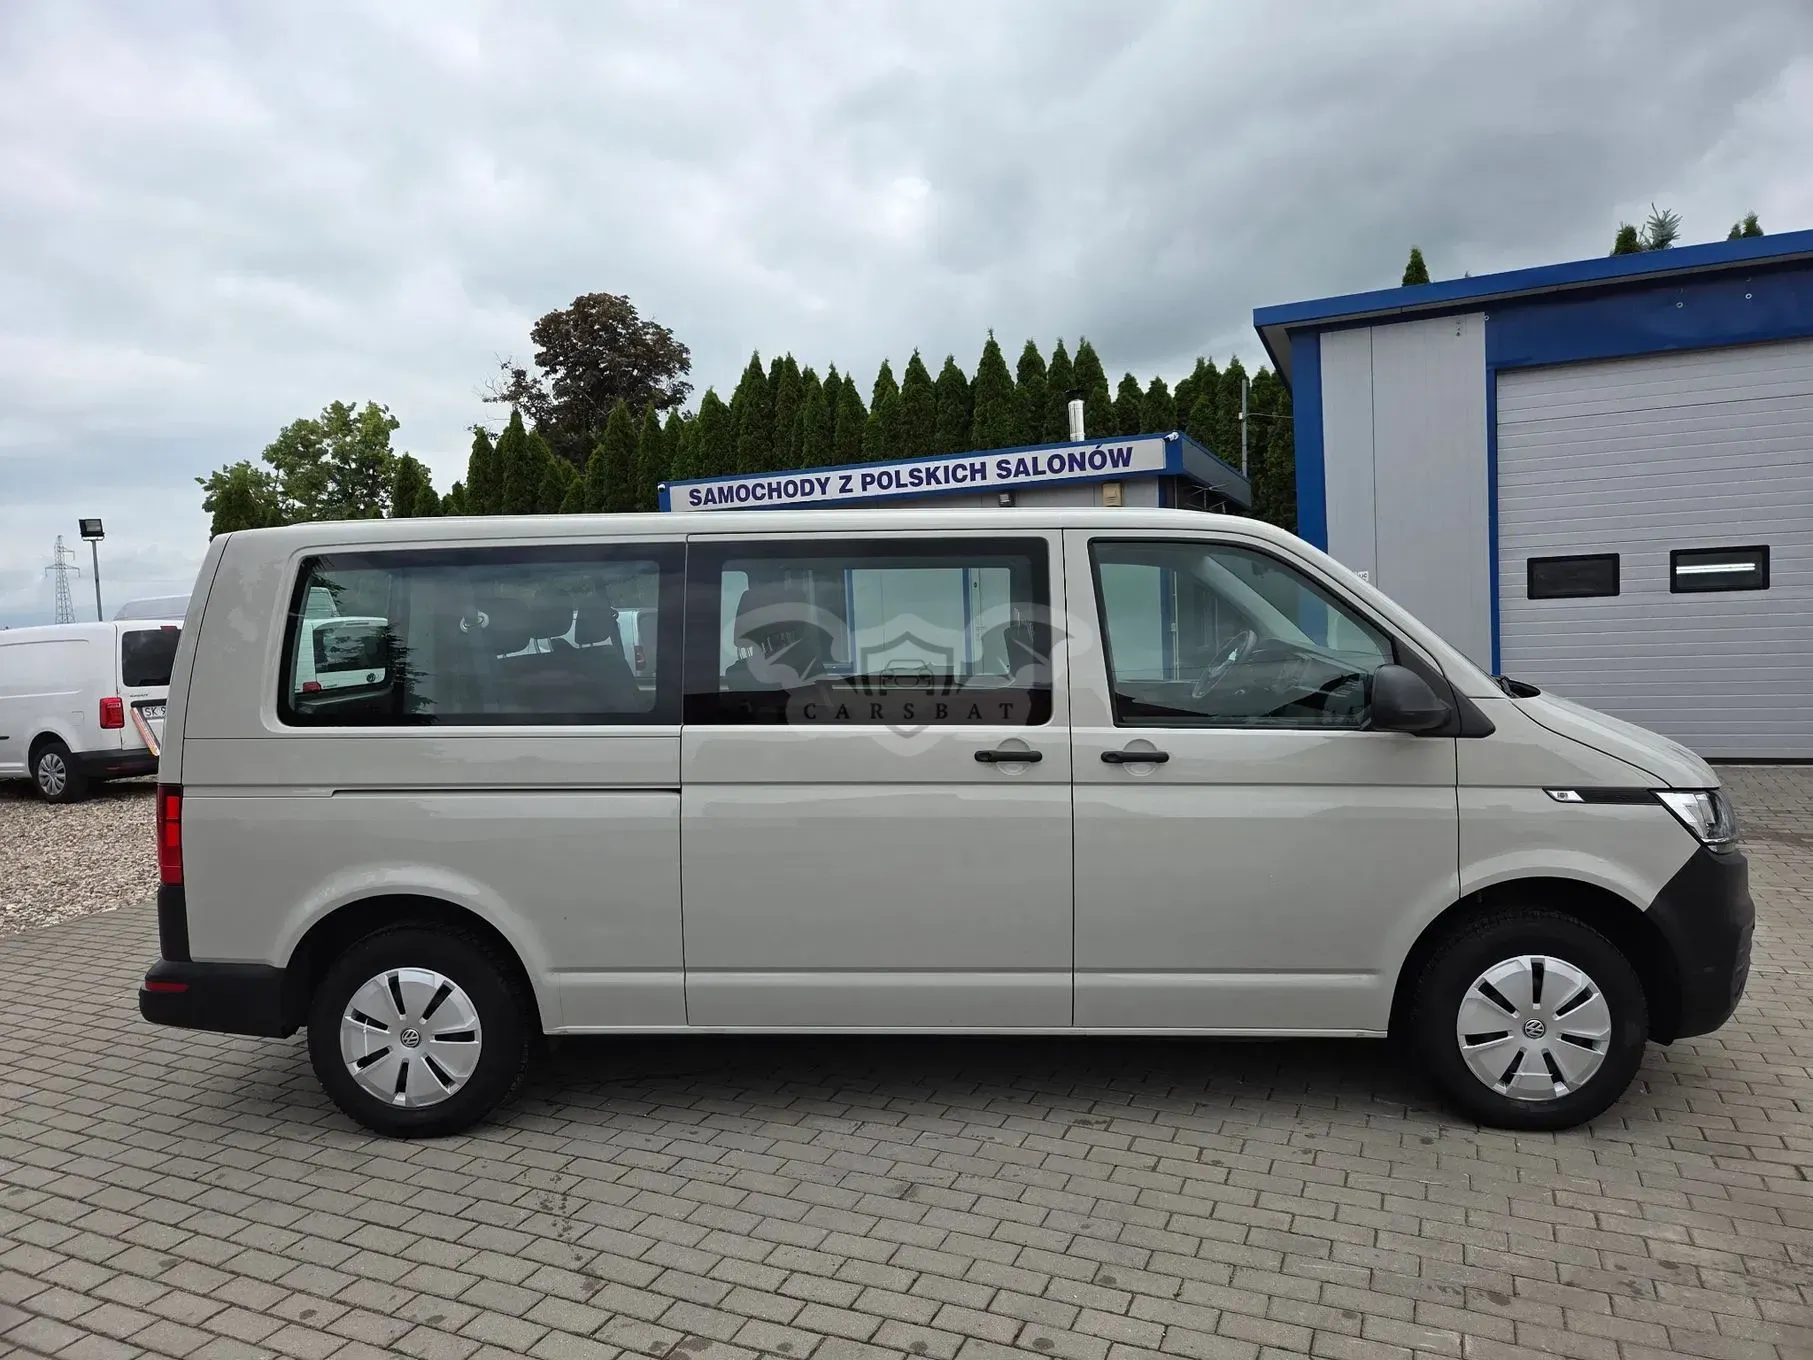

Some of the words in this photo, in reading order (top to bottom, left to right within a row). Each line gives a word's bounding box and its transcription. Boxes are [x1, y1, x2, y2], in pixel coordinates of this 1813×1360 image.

[689, 476, 831, 507] SAMOCHODY
[838, 474, 854, 494] Z
[861, 461, 987, 492] POLSKICH
[996, 443, 1133, 480] SALONÓW
